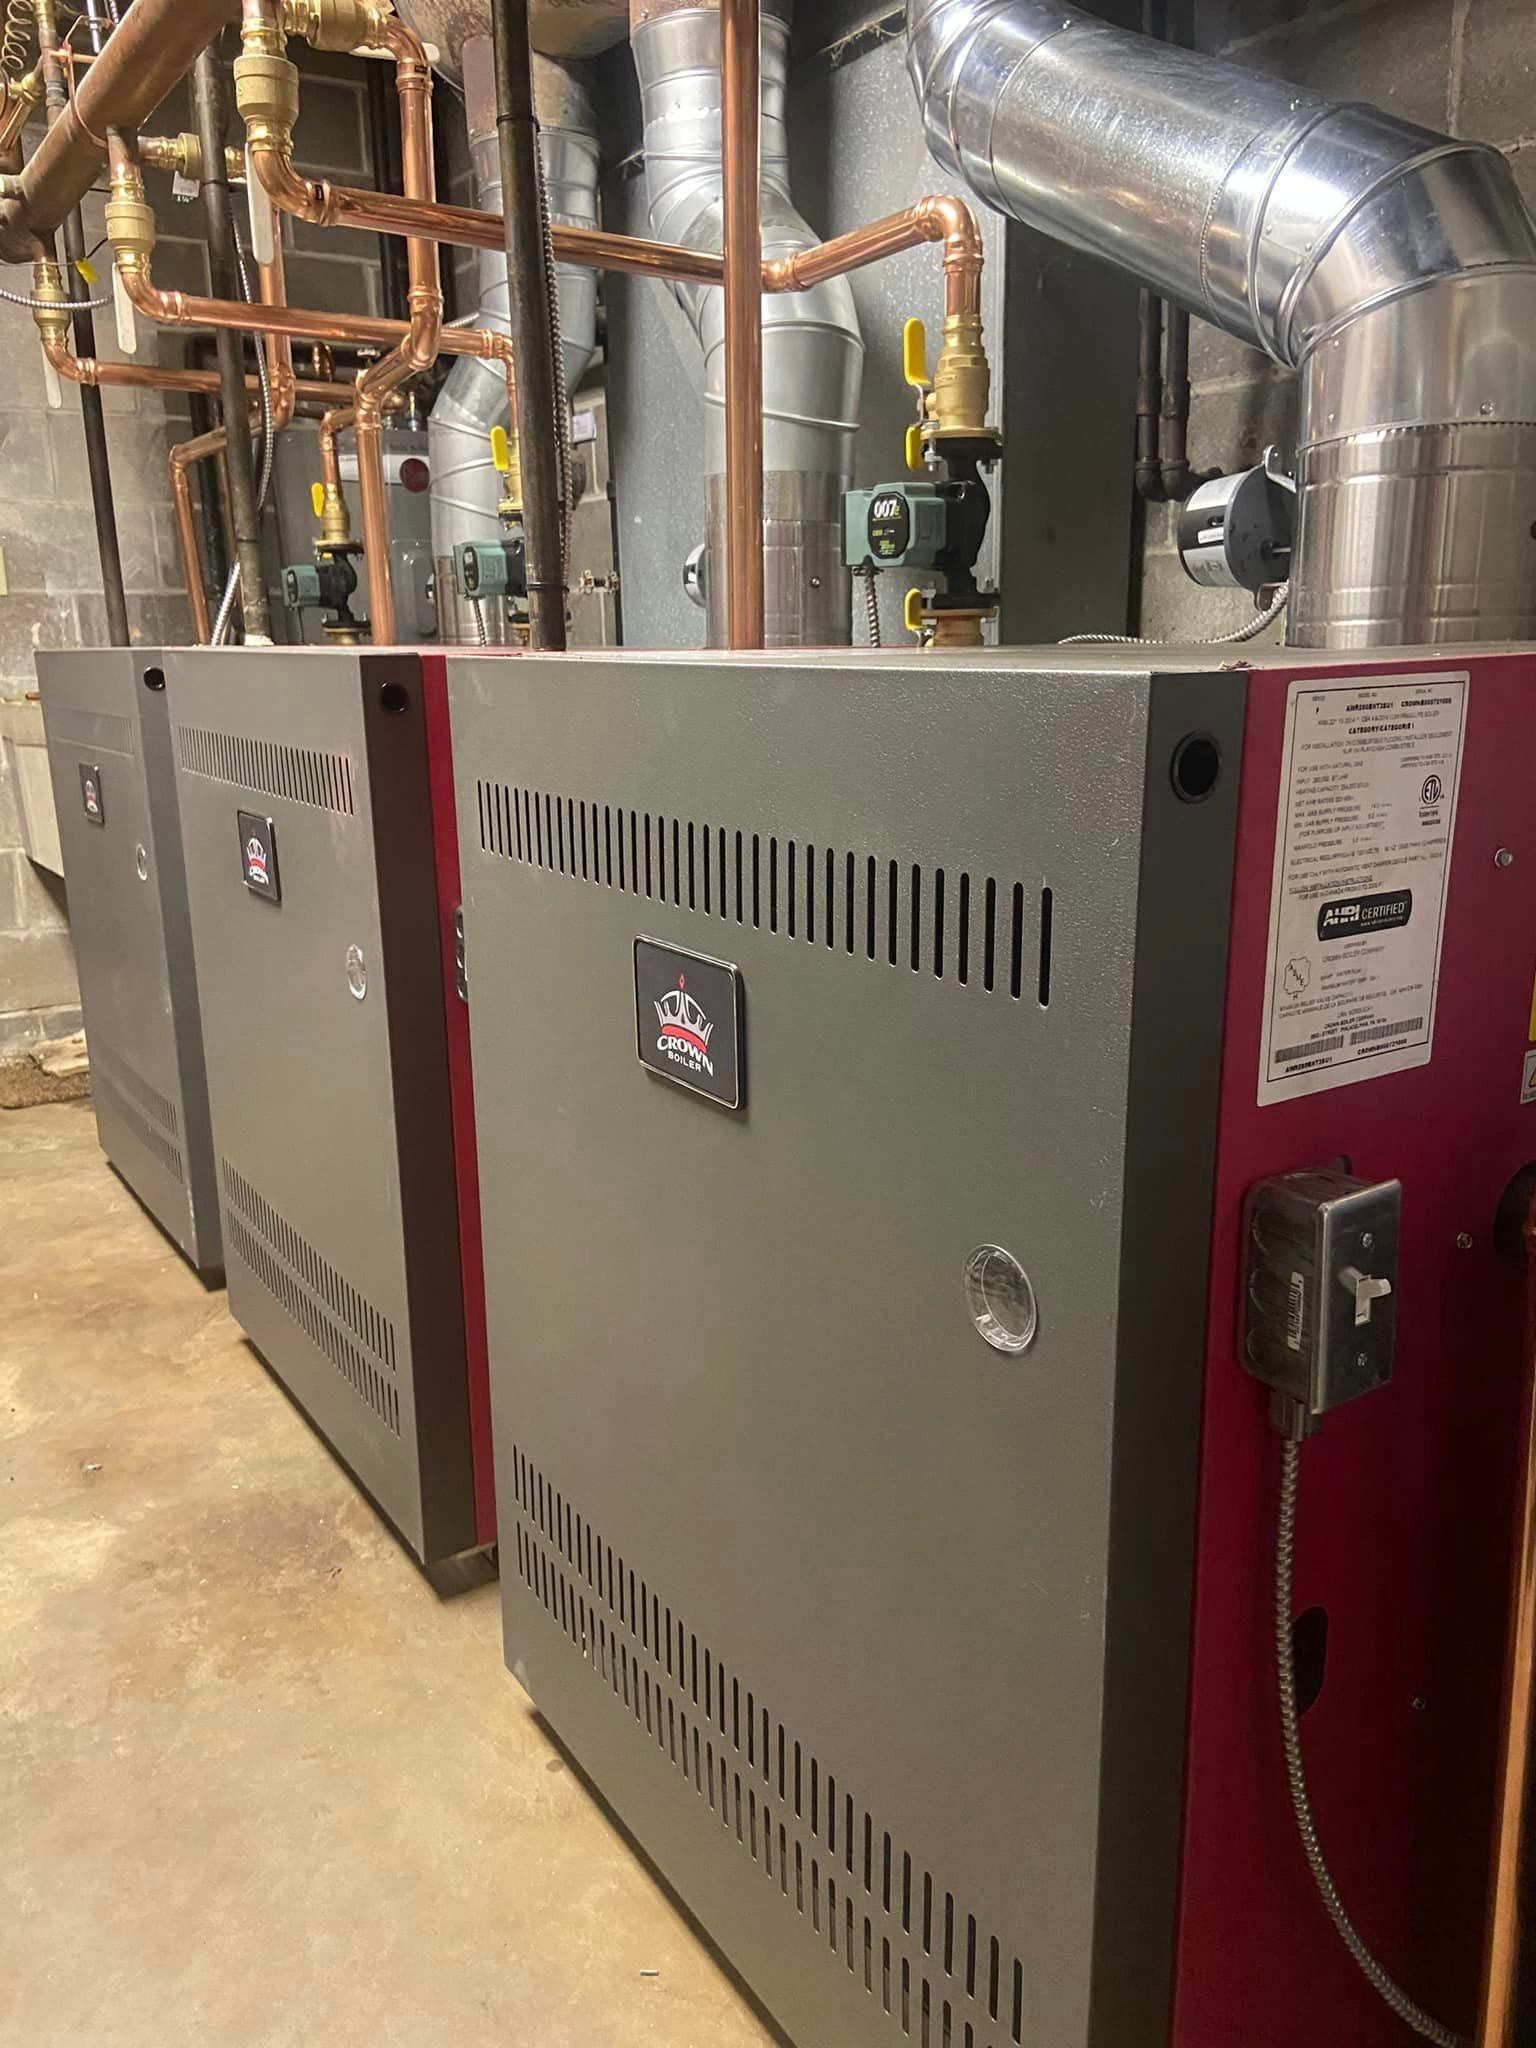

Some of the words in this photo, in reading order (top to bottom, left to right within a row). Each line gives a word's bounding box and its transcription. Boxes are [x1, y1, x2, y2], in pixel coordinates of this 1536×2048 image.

[1361, 902, 1405, 920] CERTIFIED
[656, 1034, 714, 1077] CROWN
[667, 1050, 702, 1072] BOILER
